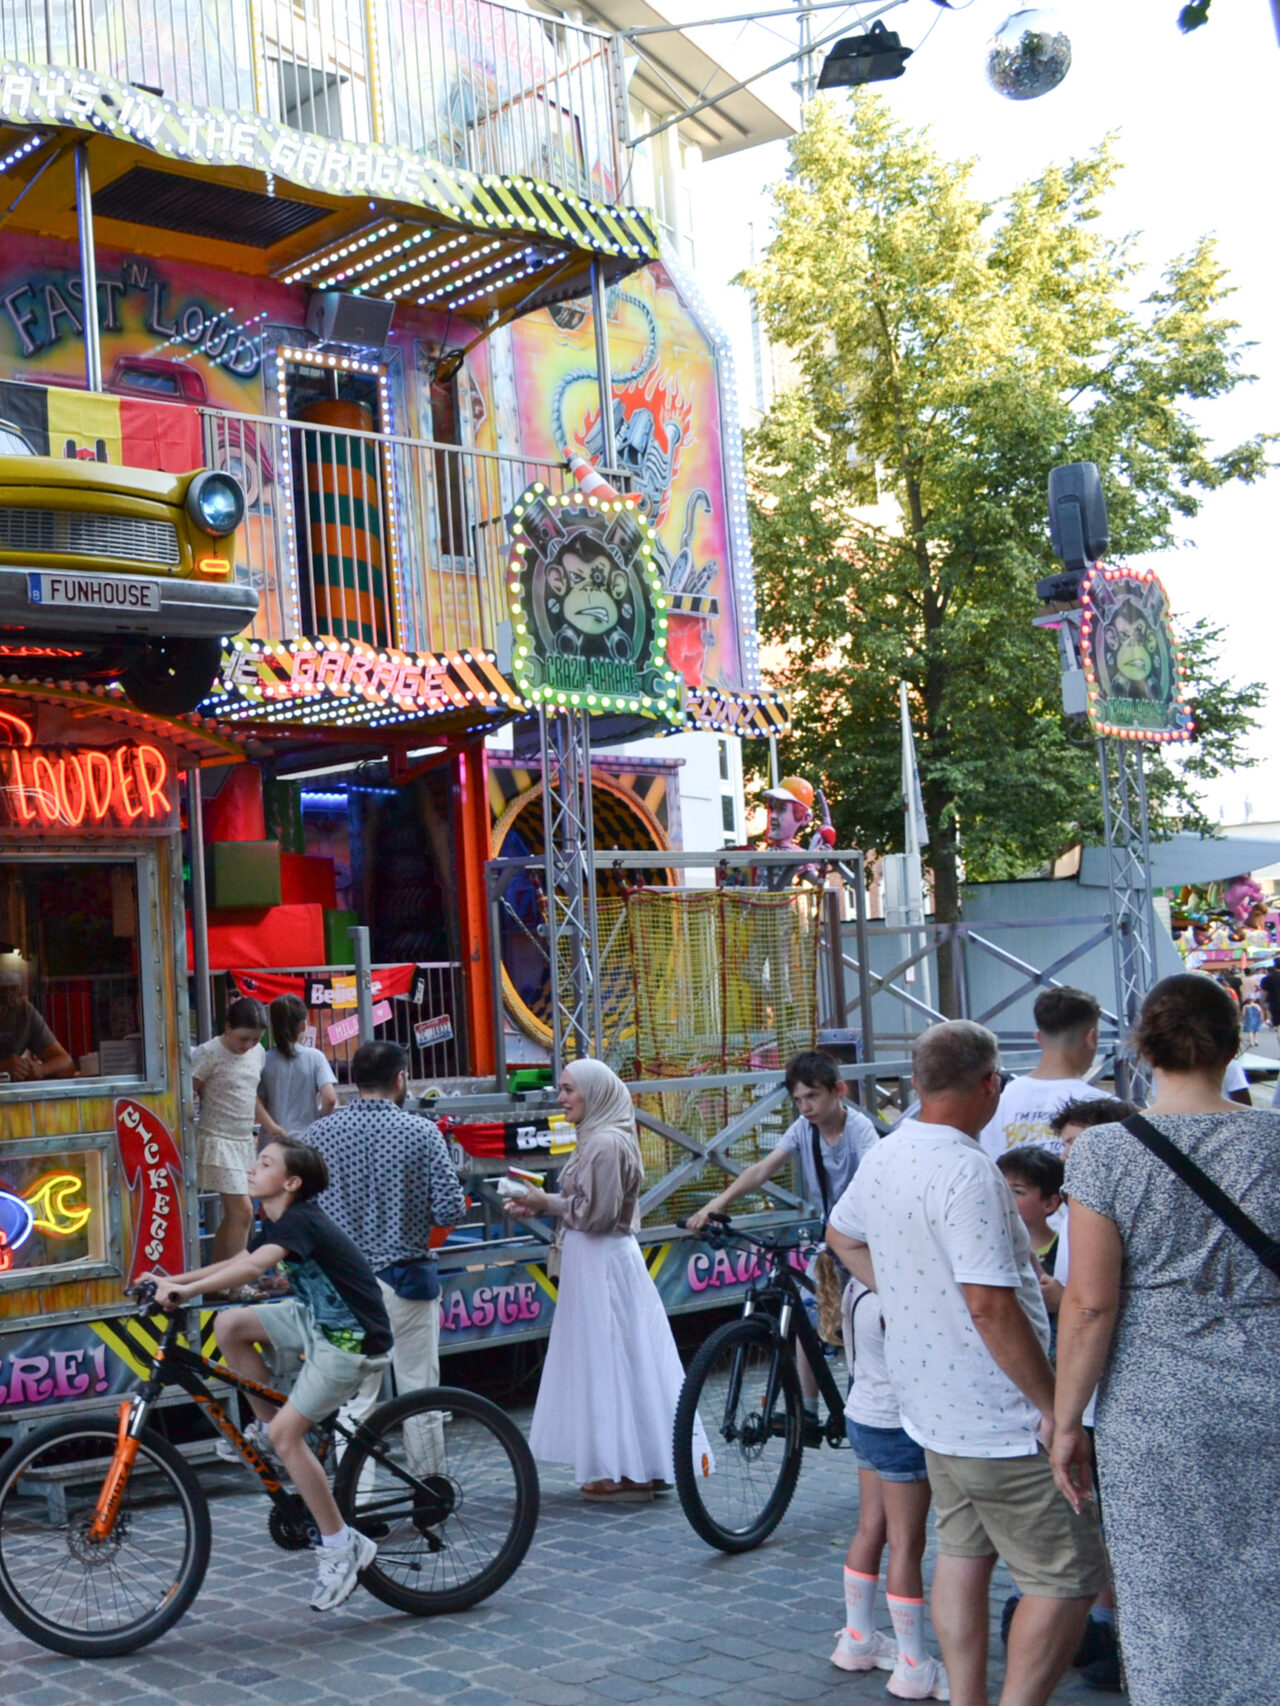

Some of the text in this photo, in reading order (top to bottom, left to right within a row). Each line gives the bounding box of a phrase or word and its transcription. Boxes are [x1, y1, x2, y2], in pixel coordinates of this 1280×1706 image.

[118, 96, 166, 138] IN
[181, 117, 259, 155] THE
[269, 138, 424, 193] GARAGE
[147, 282, 261, 378] LOUD
[50, 579, 152, 607] FUNHOUSE
[289, 650, 448, 698] GARAGE
[10, 743, 173, 828] LOUDER
[311, 978, 384, 1006] Beliee
[1003, 1120, 1056, 1150] BOSN
[118, 1105, 171, 1262] TICKETS
